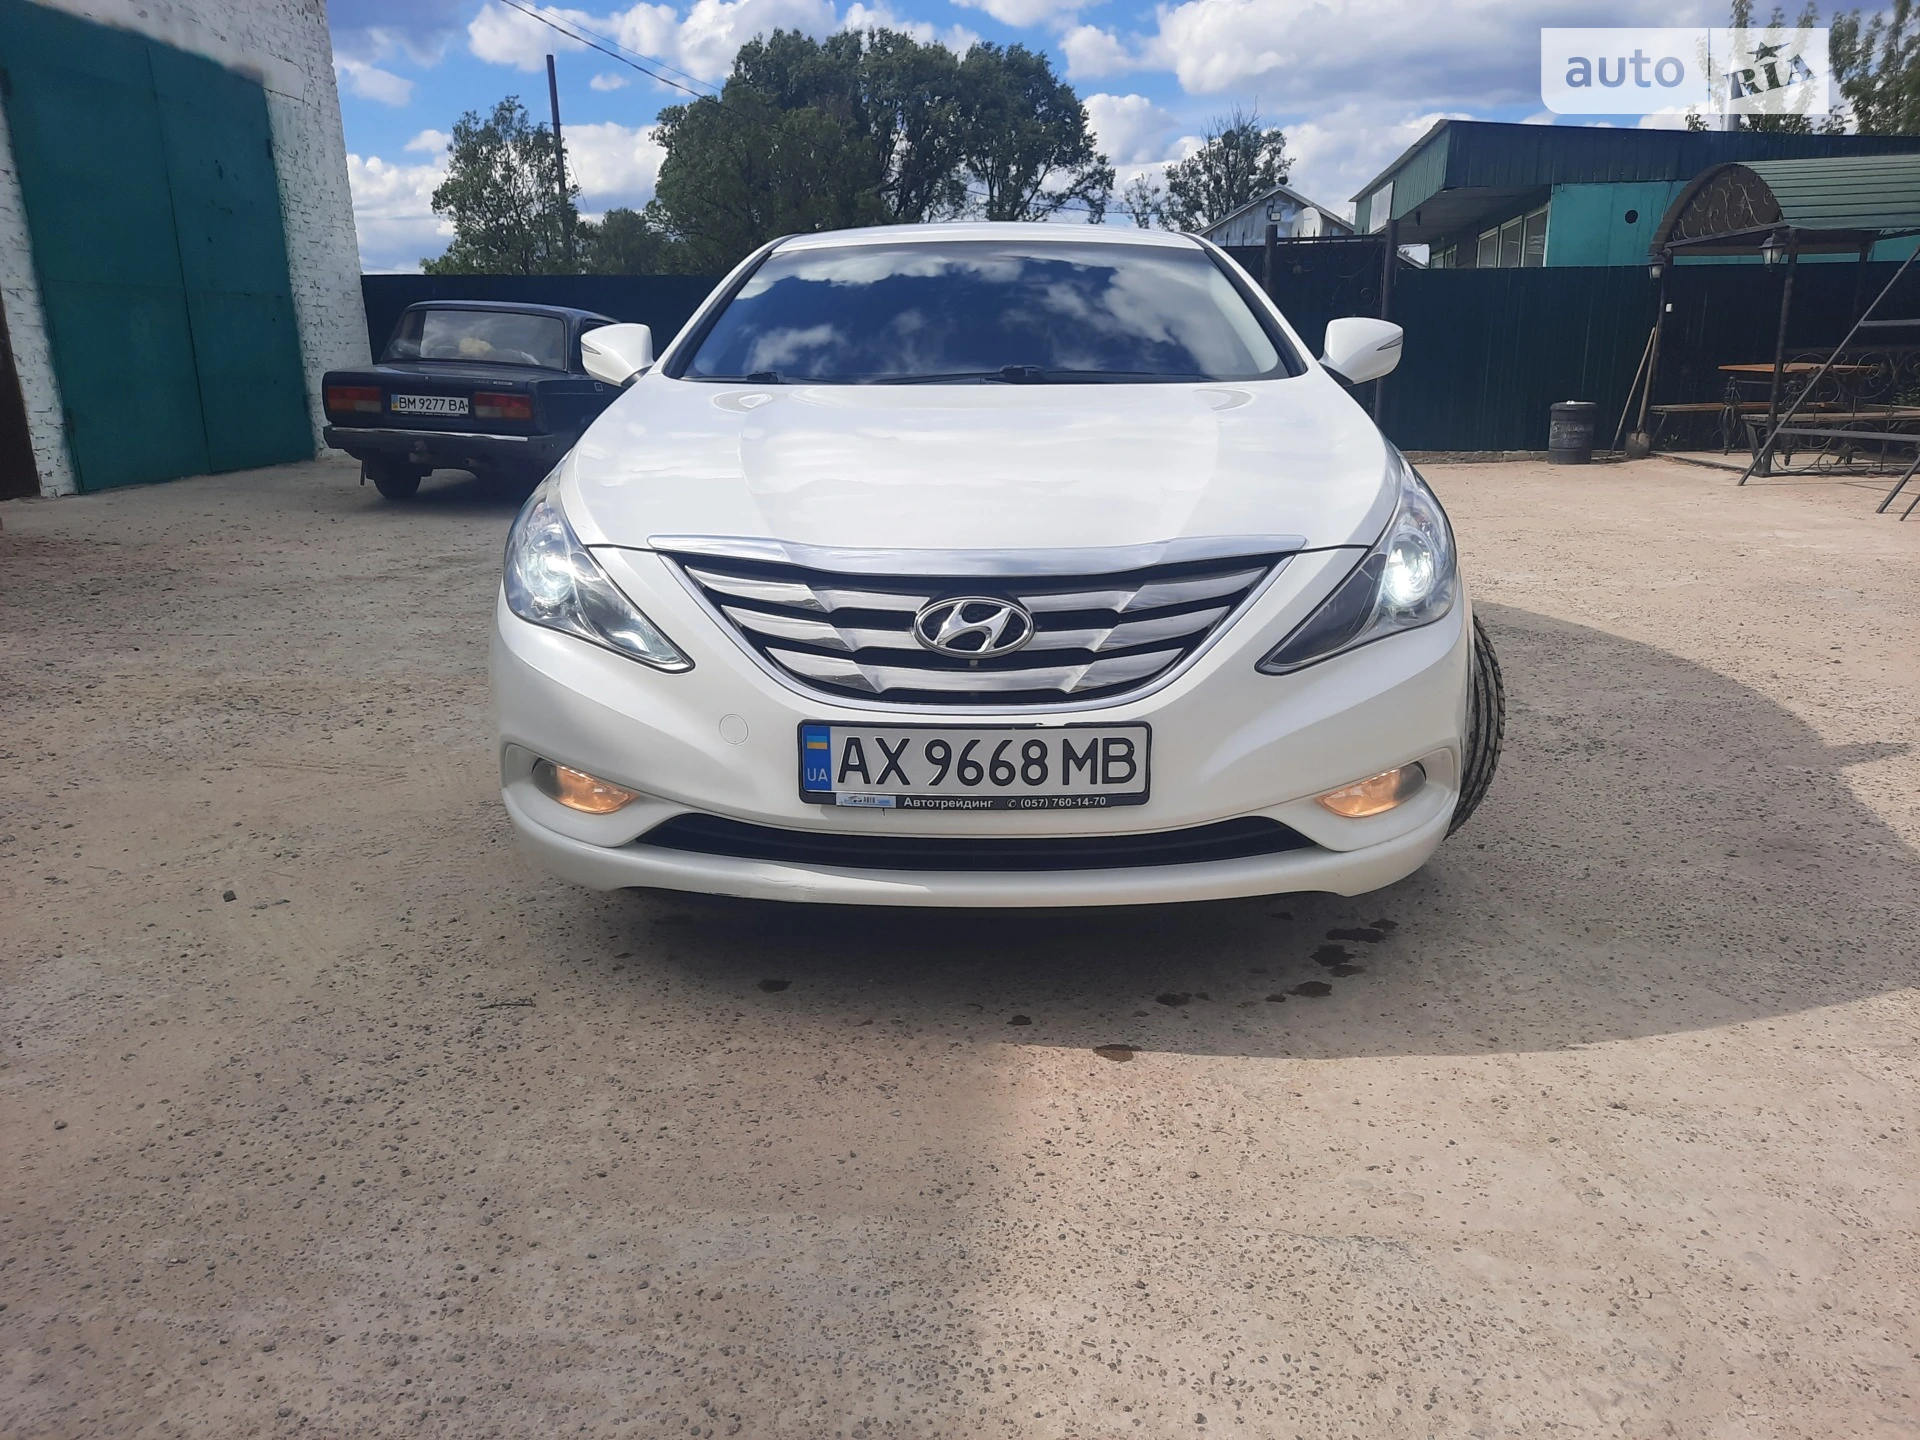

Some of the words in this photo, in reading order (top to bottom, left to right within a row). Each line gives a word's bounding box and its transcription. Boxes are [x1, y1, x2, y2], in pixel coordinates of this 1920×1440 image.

[399, 396, 417, 410] BM
[419, 397, 446, 411] 9277
[448, 399, 466, 412] BA
[837, 736, 911, 786] AX
[924, 738, 1049, 787] 9668
[1062, 737, 1137, 786] MB
[807, 767, 829, 783] UA
[903, 797, 994, 809] Автотрейдинг
[1020, 798, 1049, 809] (057)
[1052, 796, 1107, 808] 760-14-70
